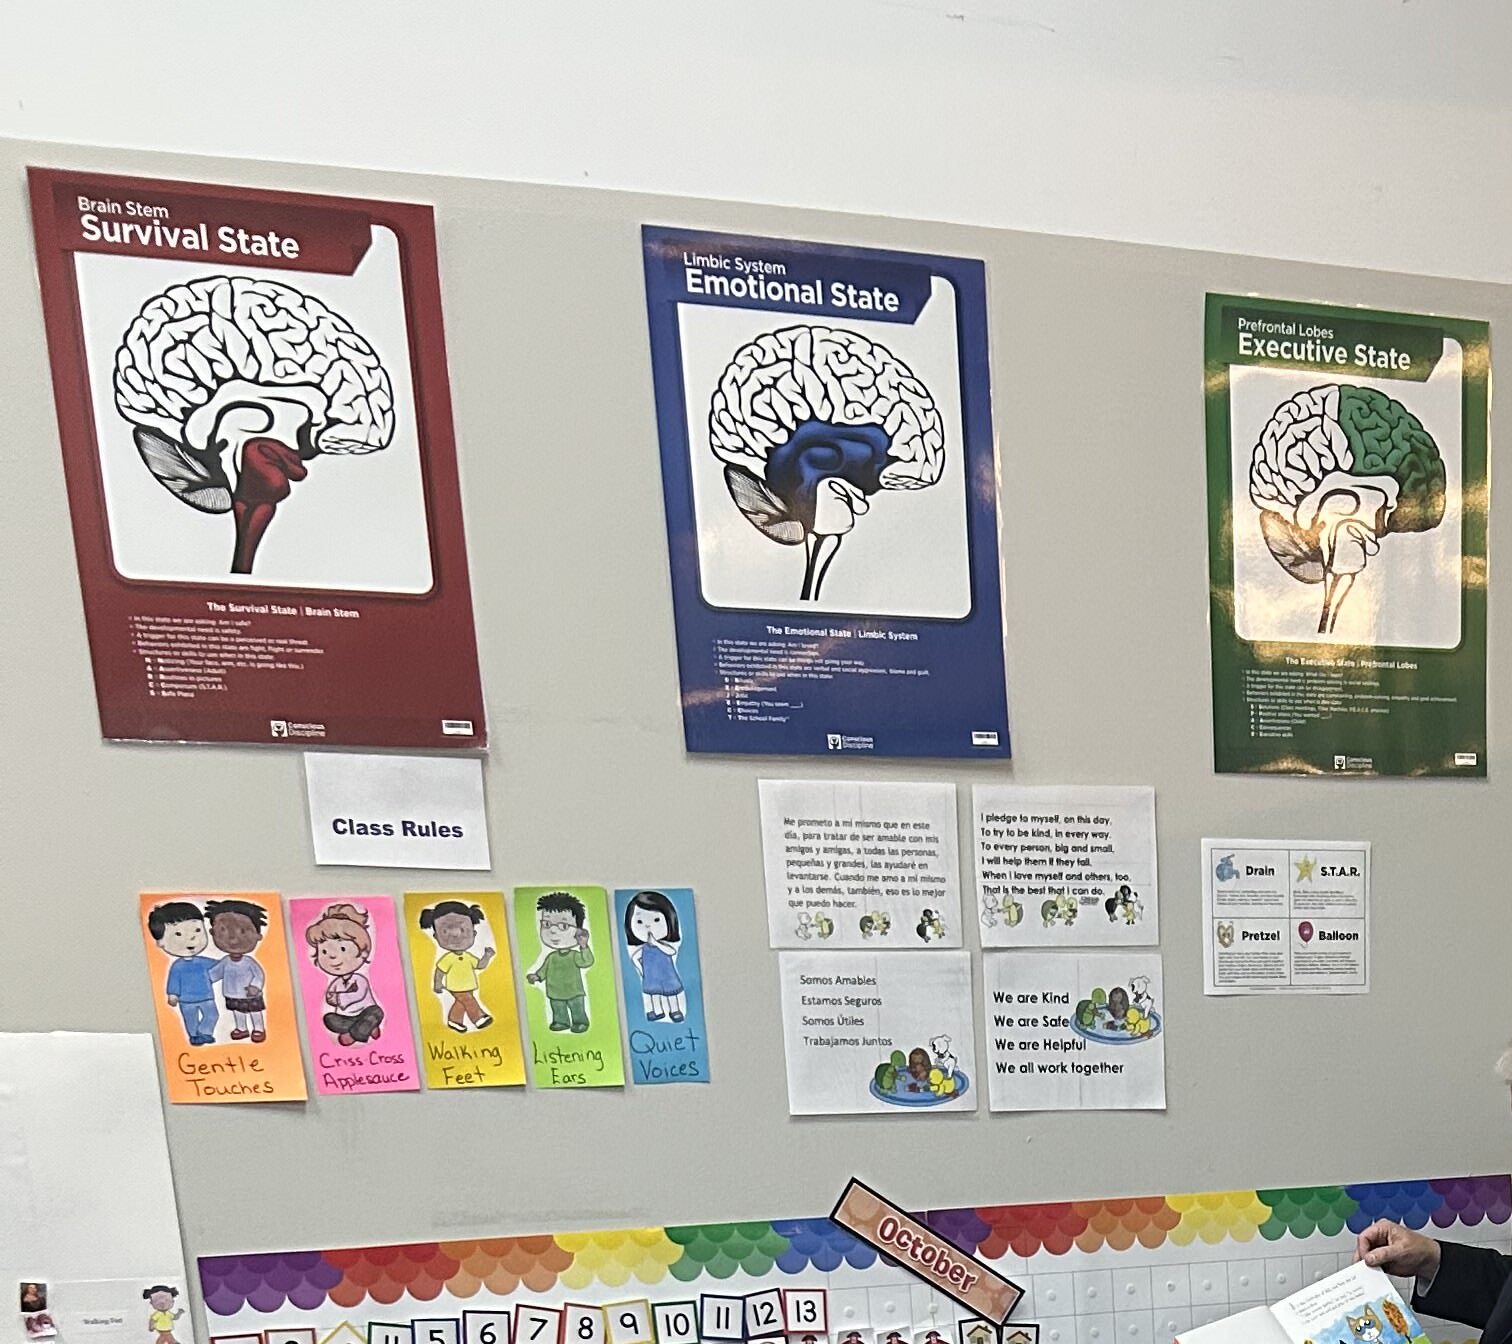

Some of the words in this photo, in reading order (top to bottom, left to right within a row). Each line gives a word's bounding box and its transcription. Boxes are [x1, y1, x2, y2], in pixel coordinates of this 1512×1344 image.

[77, 196, 122, 214] Brain
[127, 201, 170, 219] Stem
[81, 213, 209, 251] Survival
[217, 226, 300, 259] State
[683, 251, 731, 270] Limbic
[735, 257, 787, 276] System
[685, 267, 823, 305] Emotional
[830, 282, 900, 312] State
[1238, 317, 1296, 336] Prefrontal
[1299, 324, 1334, 339] Lobes
[1238, 332, 1348, 365] Executive
[1353, 343, 1411, 371] State
[207, 602, 226, 611] The
[228, 603, 269, 614] Survival
[271, 605, 297, 616] State
[305, 606, 332, 617] Brain
[334, 608, 360, 618] Stem
[766, 625, 782, 635] The
[785, 626, 827, 637] Emotional
[829, 628, 851, 639] State
[858, 630, 886, 640] Limbic
[888, 631, 918, 641] System
[986, 813, 1018, 824] pledge
[1019, 814, 1028, 823] to
[1064, 816, 1075, 824] on
[1077, 815, 1091, 824] this
[333, 818, 394, 836] Class
[402, 820, 463, 838] Rules
[982, 871, 1007, 880] When
[1014, 871, 1032, 880] love
[1035, 871, 1063, 882] myself
[1065, 872, 1083, 881] and
[1245, 865, 1275, 876] Drain
[1320, 866, 1361, 877] S.T.A.R.
[983, 885, 1000, 895] That
[1012, 885, 1025, 895] the
[1028, 886, 1046, 895] best
[1048, 886, 1065, 896] that
[1241, 930, 1281, 941] Pretzel
[1318, 930, 1359, 941] Balloon
[799, 975, 834, 986] Somos
[835, 974, 877, 987] Amables
[801, 995, 843, 1007] Estamos
[844, 995, 882, 1008] Seguros
[993, 992, 1013, 1004] We
[1017, 994, 1038, 1004] are
[1041, 991, 1070, 1004] Kind
[801, 1015, 837, 1026] Somos
[838, 1013, 865, 1026] Útiles
[993, 1015, 1014, 1028] We
[1017, 1018, 1039, 1028] are
[1041, 1014, 1070, 1028] Safe
[629, 1028, 699, 1054] Quiet
[803, 1035, 860, 1048] Trabajamos
[861, 1036, 893, 1047] Juntos
[994, 1038, 1016, 1051] We
[1019, 1041, 1040, 1051] are
[1043, 1038, 1087, 1053] Helpful
[428, 1041, 502, 1066] Walking
[533, 1040, 604, 1071] Listening
[178, 1051, 265, 1076] Gentle
[639, 1059, 700, 1080] Voices
[995, 1062, 1016, 1075] We
[1020, 1062, 1034, 1075] all
[1037, 1062, 1068, 1075] work
[1070, 1062, 1124, 1076] together
[323, 1070, 410, 1090] Applesauce
[442, 1066, 486, 1084] Feet
[551, 1068, 587, 1084] Ears
[185, 1077, 274, 1096] Touches
[878, 1215, 978, 1293] October
[479, 1322, 496, 1344] 6
[529, 1317, 549, 1340] 7
[578, 1316, 594, 1339] 8
[620, 1311, 639, 1335] 9
[665, 1312, 690, 1336] 10
[715, 1306, 730, 1329] 11
[752, 1301, 777, 1326] 12
[795, 1300, 817, 1323] 13
